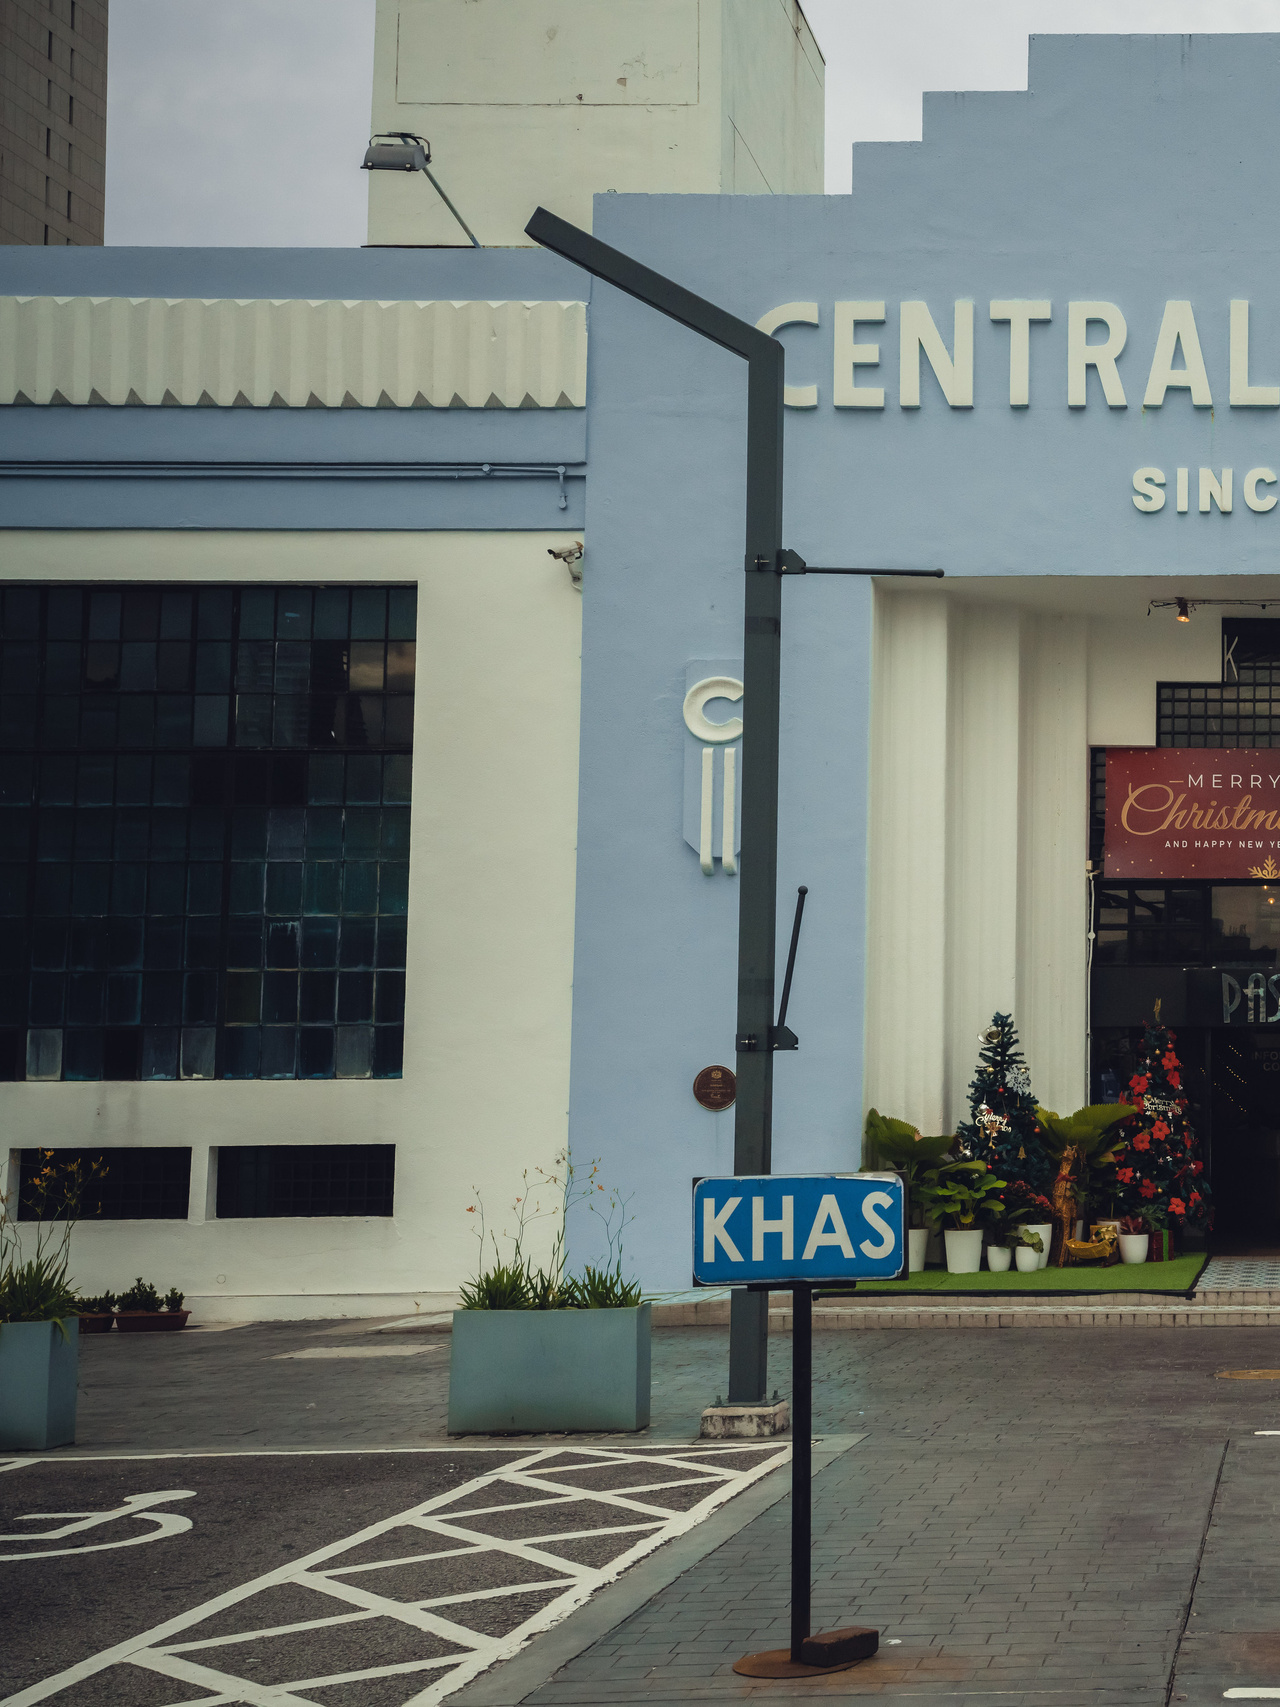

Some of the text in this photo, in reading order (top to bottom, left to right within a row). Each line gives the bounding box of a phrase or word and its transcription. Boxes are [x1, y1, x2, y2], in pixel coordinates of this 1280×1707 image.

[756, 300, 1280, 409] CENTRAL
[1188, 774, 1280, 788] MERRY
[1165, 840, 1188, 848] AND
[1195, 840, 1233, 848] HAPPY
[1239, 841, 1264, 849] NEW
[702, 1191, 896, 1263] KHAS
